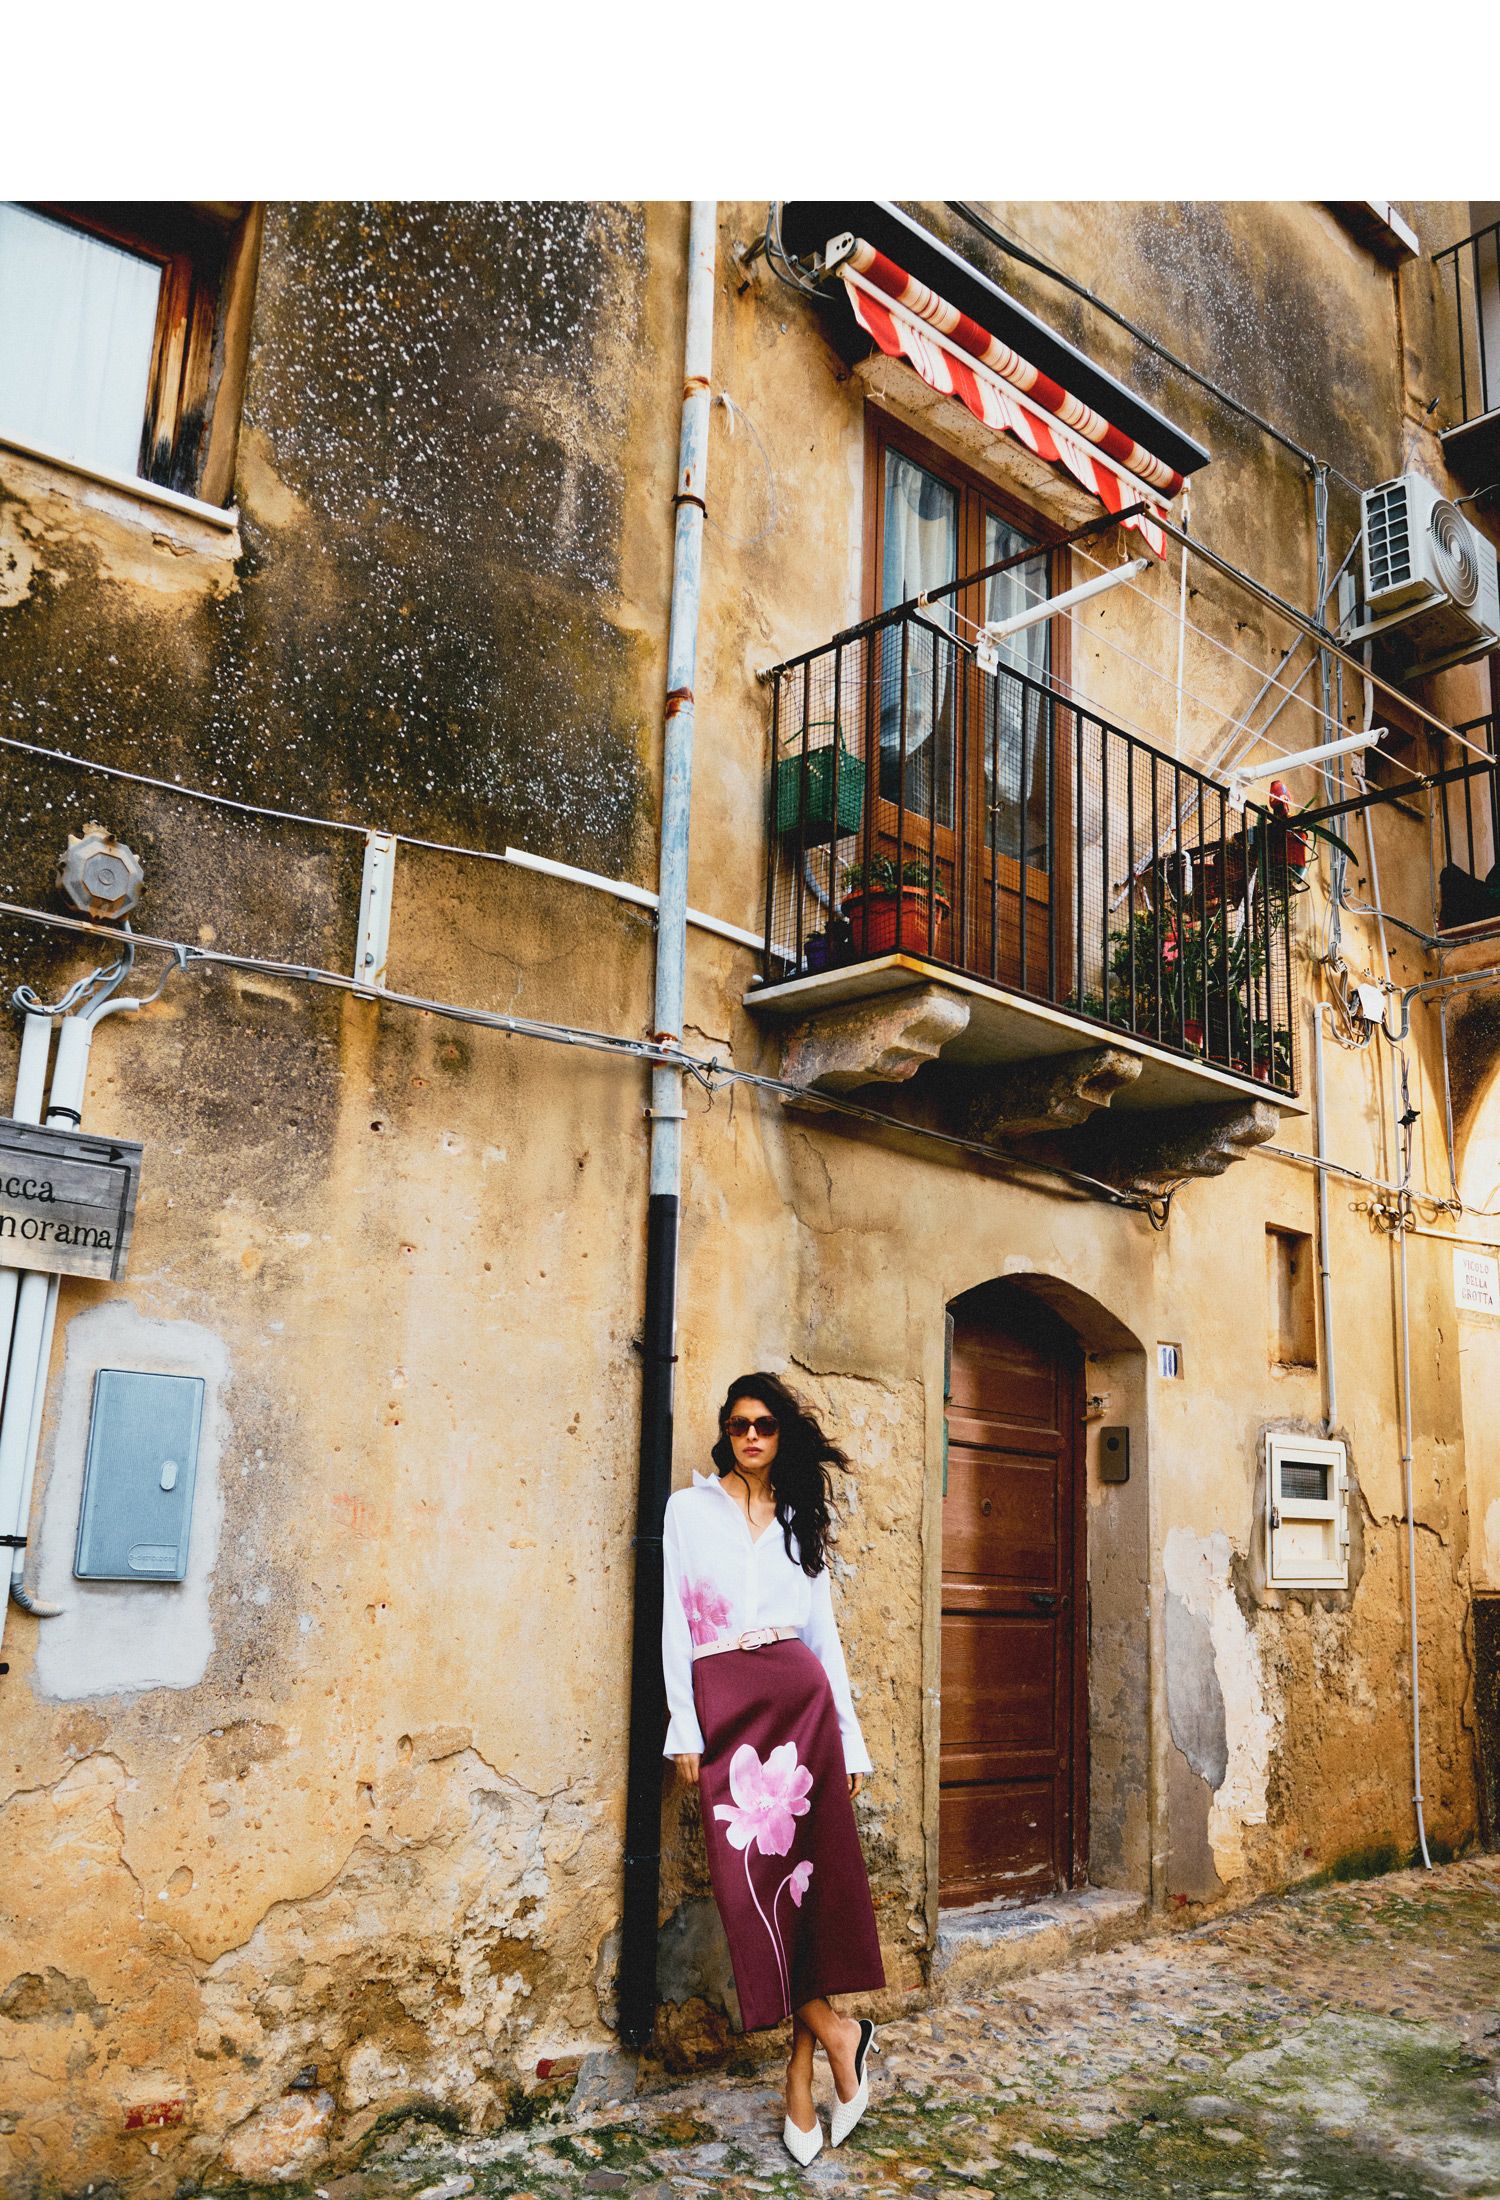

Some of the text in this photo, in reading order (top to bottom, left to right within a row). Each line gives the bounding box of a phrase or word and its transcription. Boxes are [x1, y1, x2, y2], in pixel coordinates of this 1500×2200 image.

[0, 1177, 55, 1203] cca
[1463, 1258, 1489, 1274] VICOLO
[1465, 1274, 1488, 1289] DELLA
[1461, 1287, 1494, 1306] GROTTA
